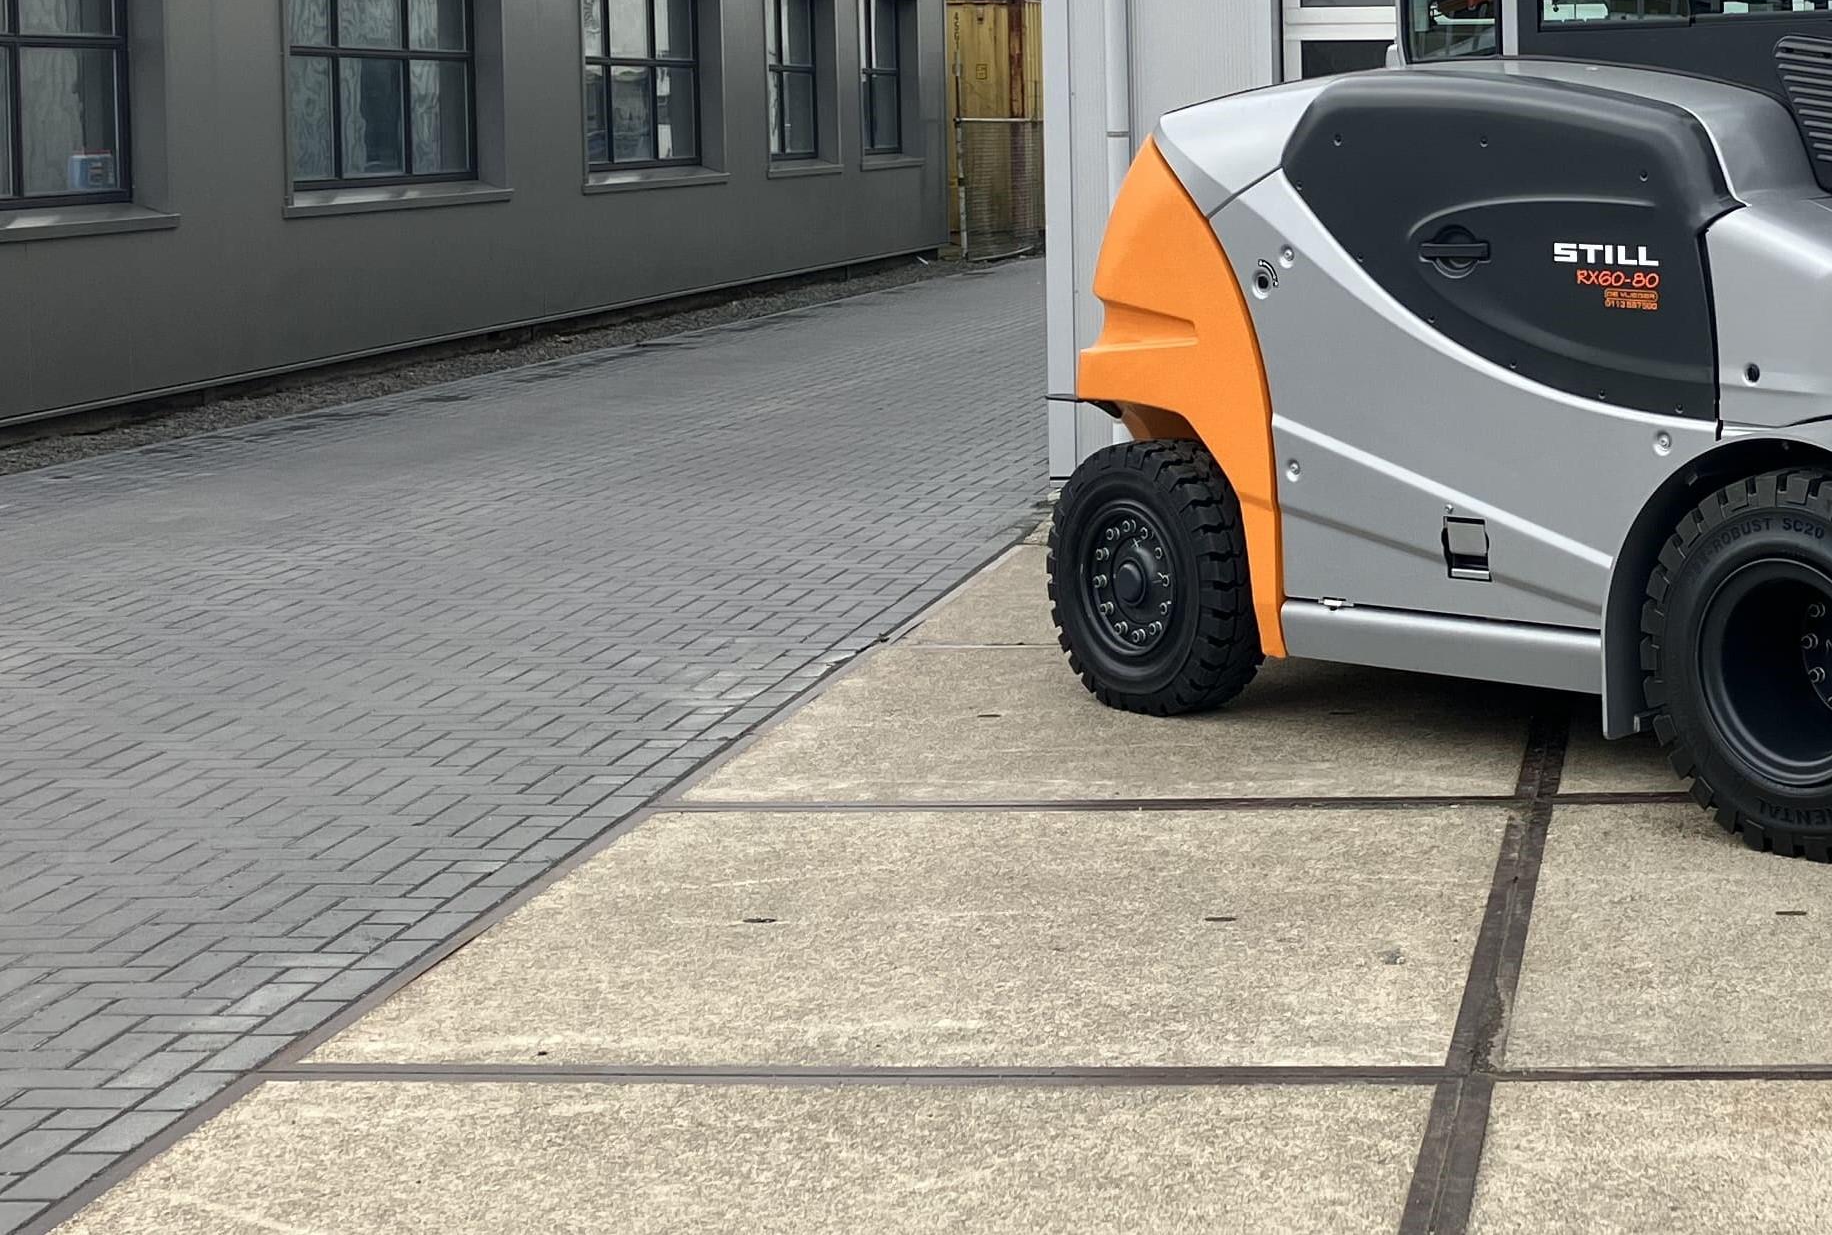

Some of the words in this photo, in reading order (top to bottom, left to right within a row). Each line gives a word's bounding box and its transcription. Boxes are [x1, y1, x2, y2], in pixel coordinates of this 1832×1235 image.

[1553, 242, 1659, 266] STILL
[1576, 269, 1659, 288] RX60-80
[1781, 517, 1826, 540] SC20
